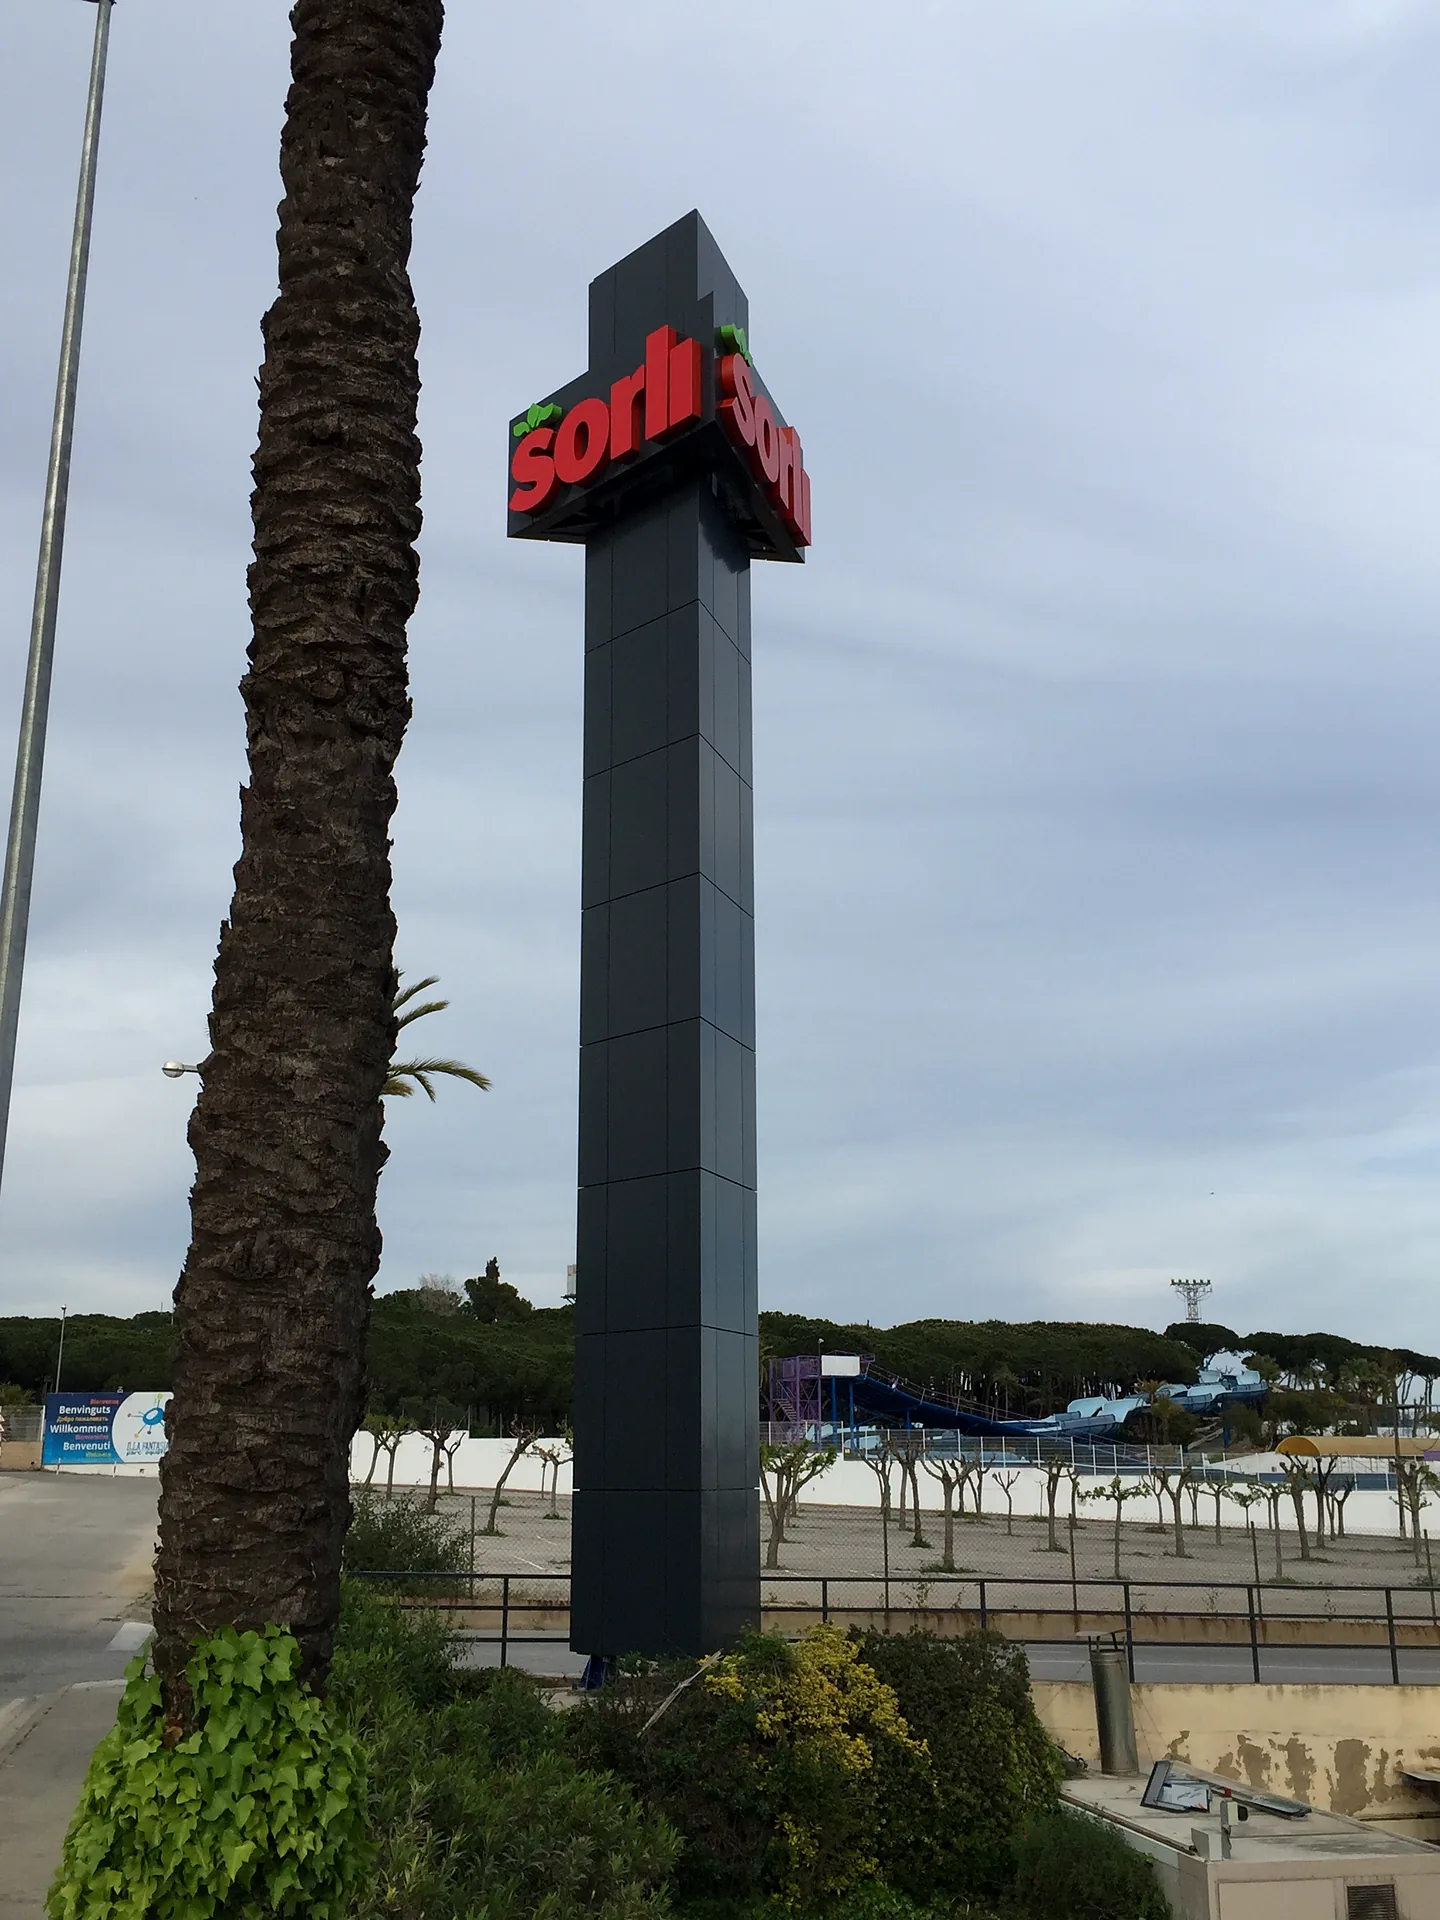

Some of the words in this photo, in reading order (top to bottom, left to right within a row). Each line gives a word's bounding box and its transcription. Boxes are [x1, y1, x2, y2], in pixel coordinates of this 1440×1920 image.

[508, 324, 702, 513] sorli
[59, 1405, 111, 1416] Benvinguts
[50, 1424, 109, 1433] Willkommen
[63, 1441, 111, 1450] Benvenuti
